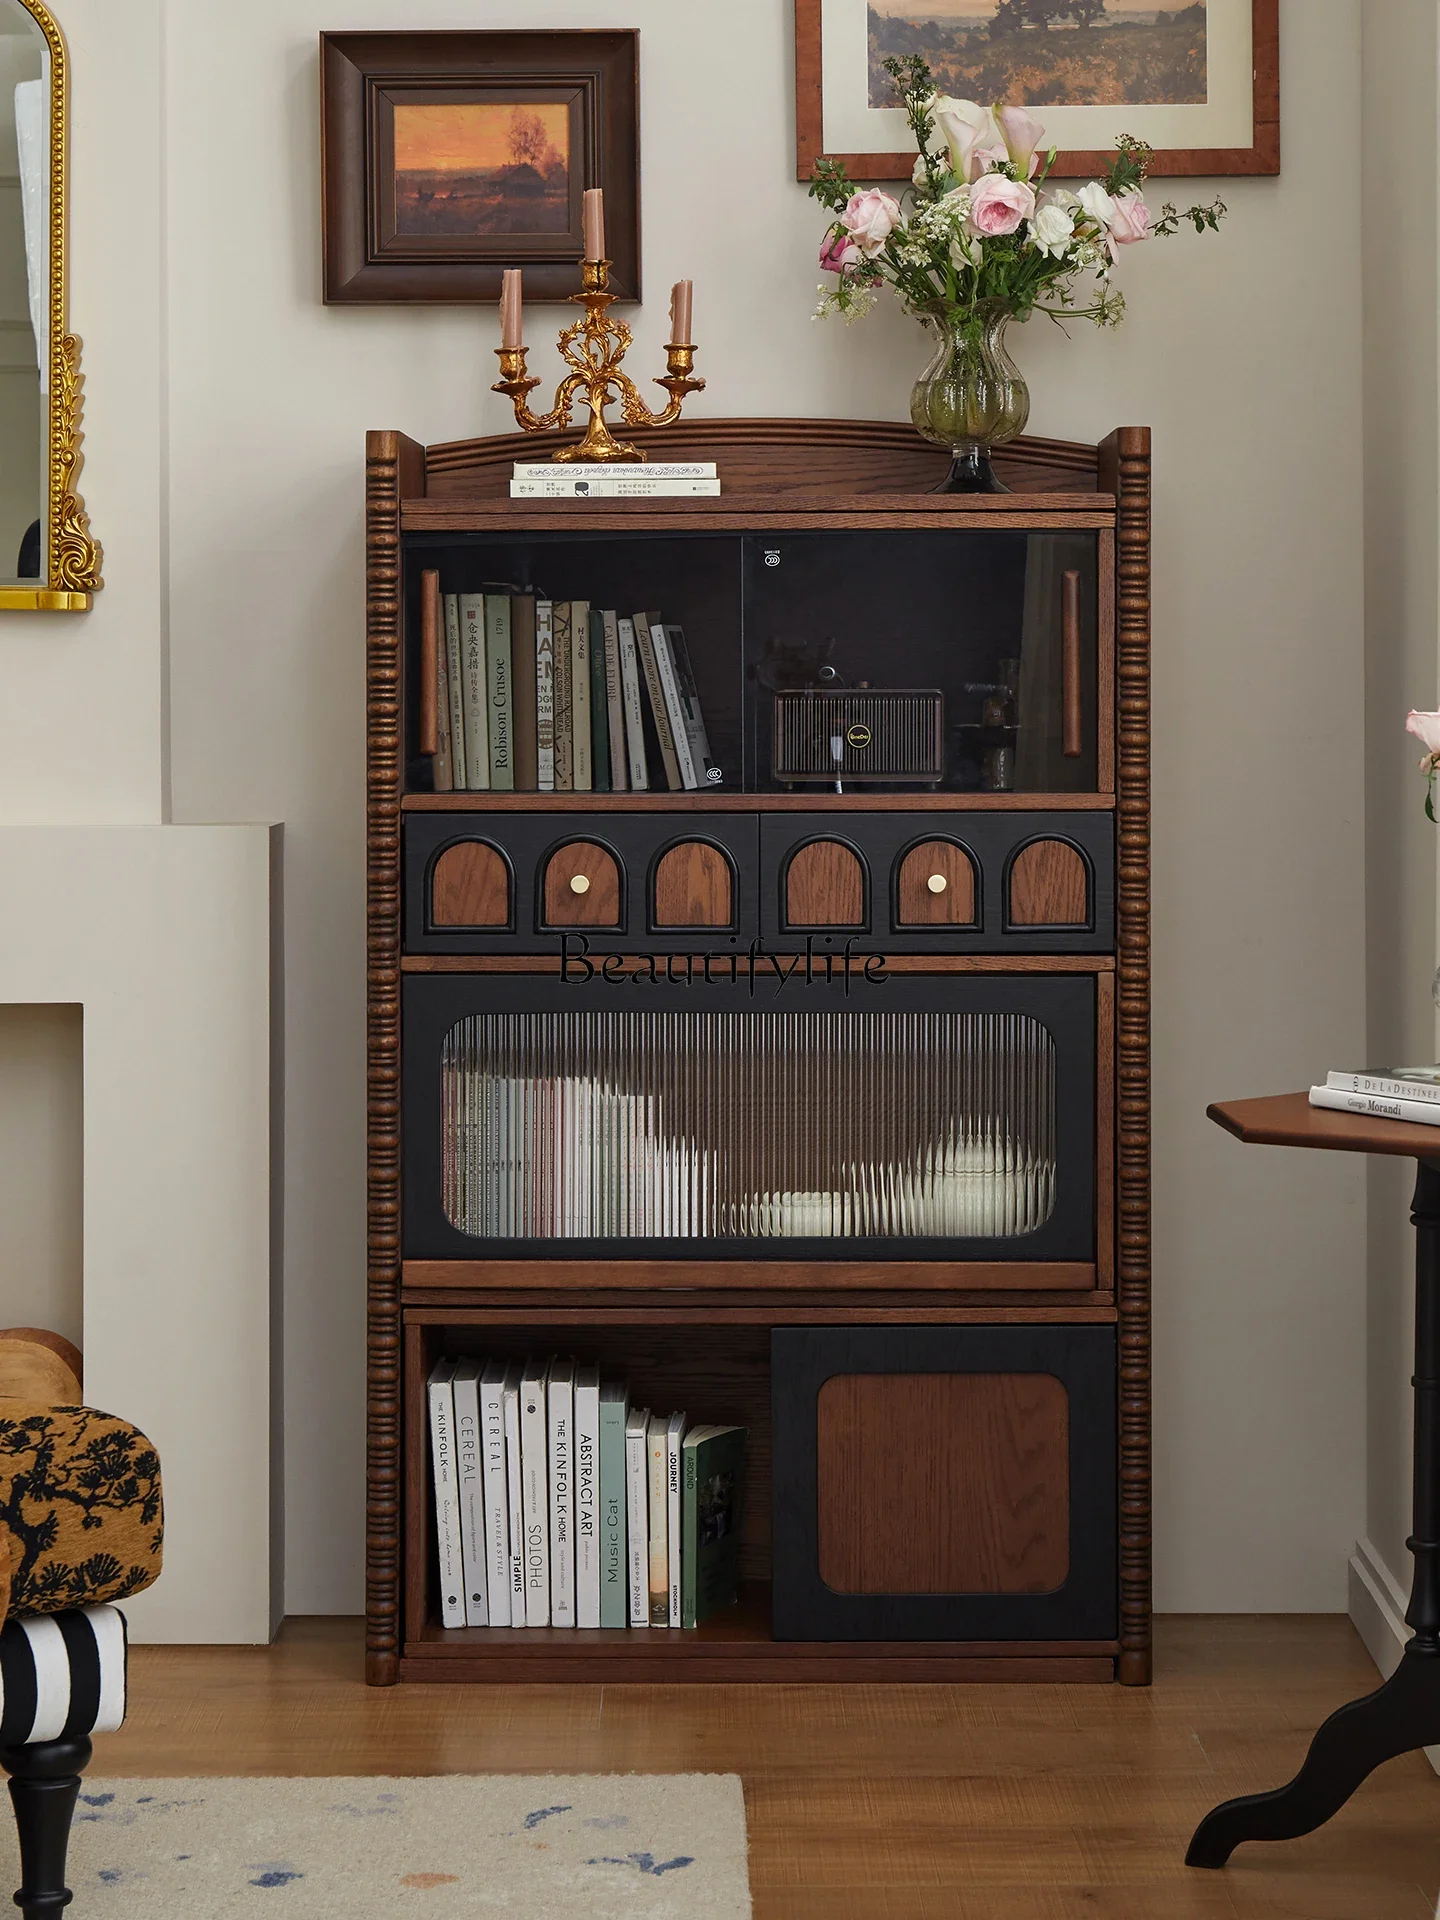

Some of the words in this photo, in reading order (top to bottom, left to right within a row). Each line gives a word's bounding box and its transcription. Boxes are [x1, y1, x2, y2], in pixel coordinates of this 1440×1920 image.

[639, 629, 651, 656] Learn
[493, 658, 507, 707] Crusoe
[563, 650, 571, 699] UNDERGROUND
[645, 657, 655, 682] more
[651, 683, 658, 695] on
[653, 697, 663, 715] our
[494, 712, 508, 769] Robison
[658, 715, 674, 751] Journal
[1368, 1100, 1401, 1115] Morandi
[438, 1414, 448, 1467] KINFOLK
[488, 1402, 502, 1472] CEREAL
[557, 1419, 565, 1437] THE
[461, 1416, 476, 1484] CEREAL
[556, 1442, 567, 1514] KINFOLK
[580, 1433, 593, 1506] ABSTRACT
[669, 1451, 678, 1493] JOURNEY
[686, 1456, 695, 1490] AROUND
[558, 1517, 566, 1543] HOME
[580, 1510, 593, 1537] ART
[607, 1498, 618, 1527] Cat
[513, 1555, 522, 1593] SIMPLE
[528, 1524, 543, 1588] PHOTOS
[607, 1532, 618, 1583] Music
